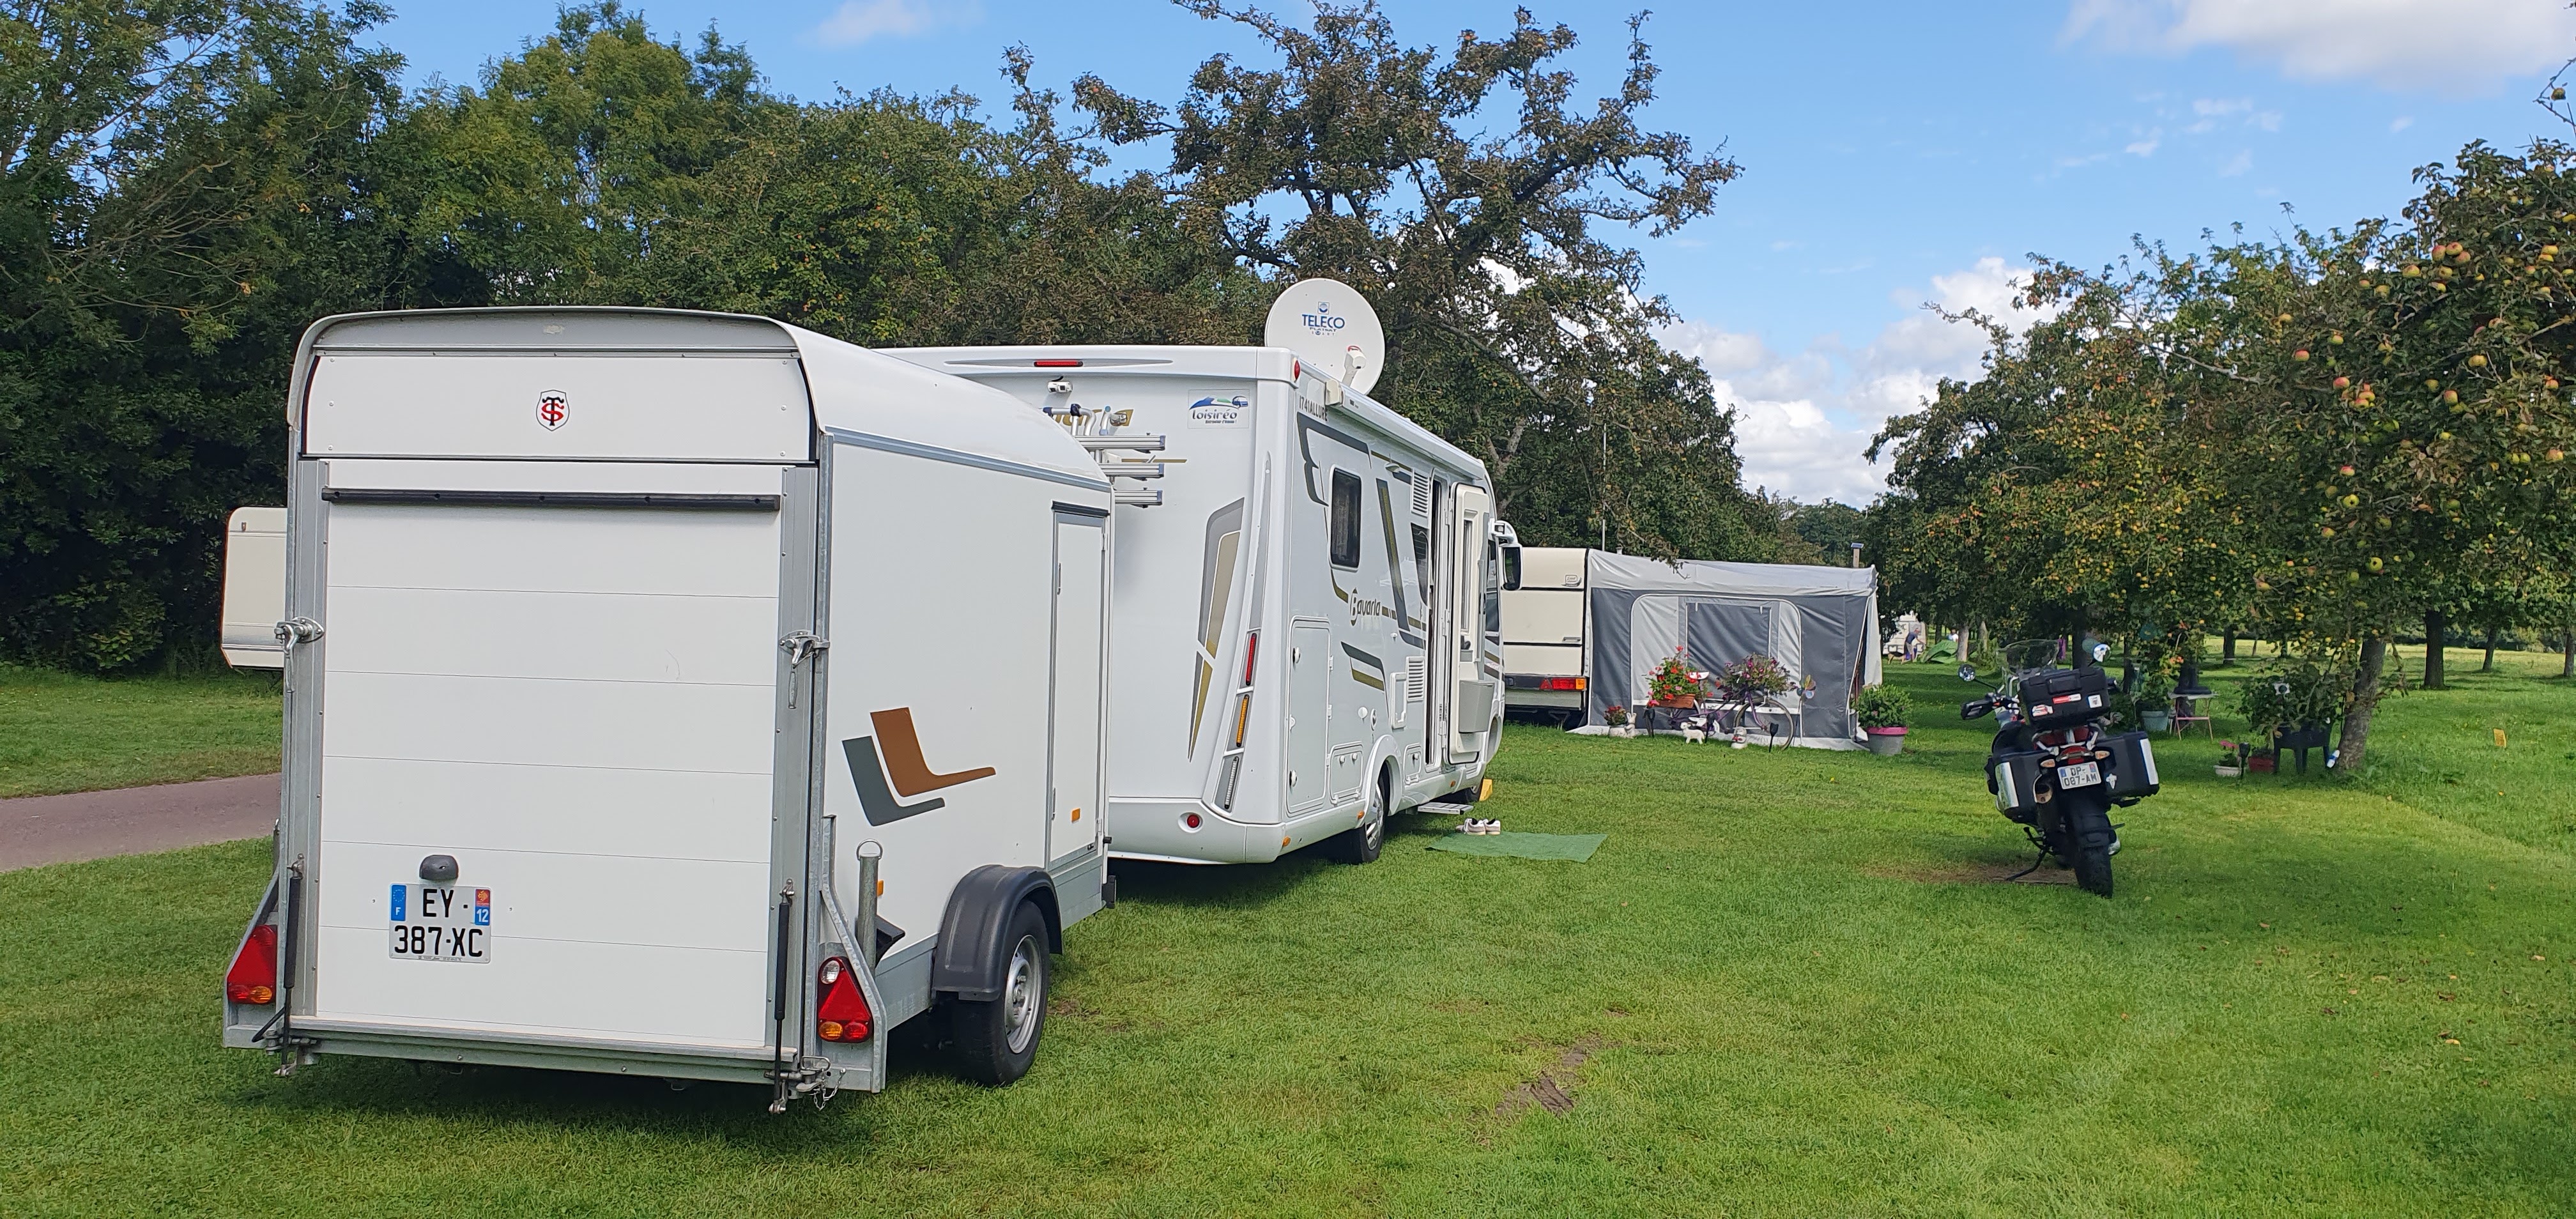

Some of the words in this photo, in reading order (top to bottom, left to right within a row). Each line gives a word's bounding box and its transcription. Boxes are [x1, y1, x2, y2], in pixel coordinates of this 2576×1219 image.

[1301, 314, 1345, 329] TELECO
[395, 907, 401, 916] F
[477, 908, 489, 923] 12
[394, 925, 483, 957] 387-XC
